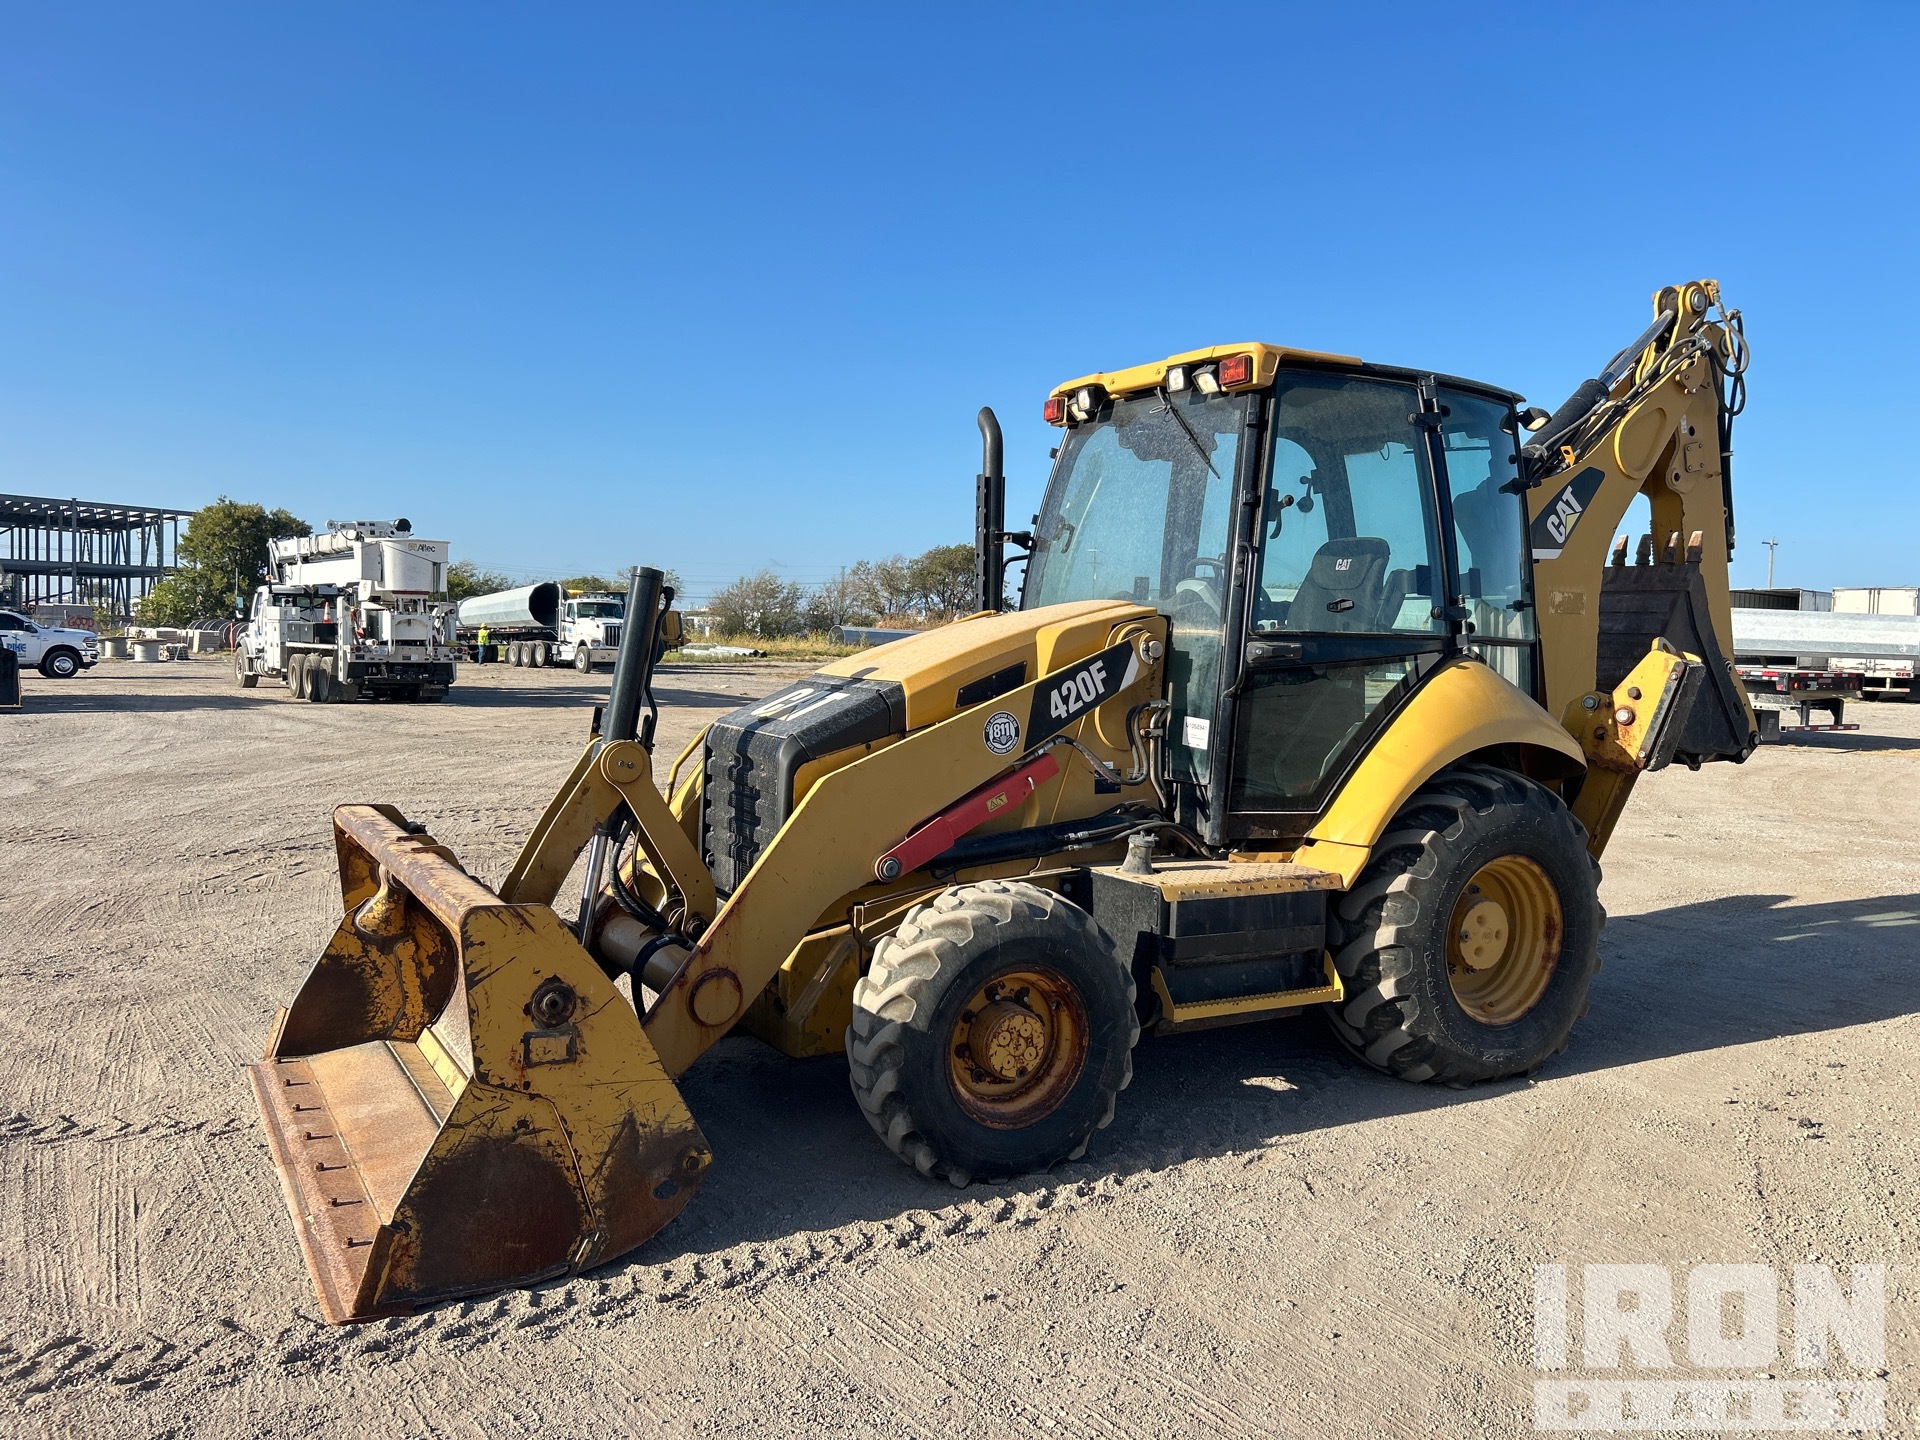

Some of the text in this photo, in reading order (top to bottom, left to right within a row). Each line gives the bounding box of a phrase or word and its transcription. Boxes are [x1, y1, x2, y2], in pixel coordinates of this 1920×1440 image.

[1546, 485, 1582, 544] CAT
[1335, 558, 1352, 571] CAT
[67, 616, 94, 627] GOOD
[6, 643, 26, 652] PIKE
[1050, 659, 1107, 719] 420F
[750, 688, 851, 721] CAT
[993, 721, 1010, 738] 811
